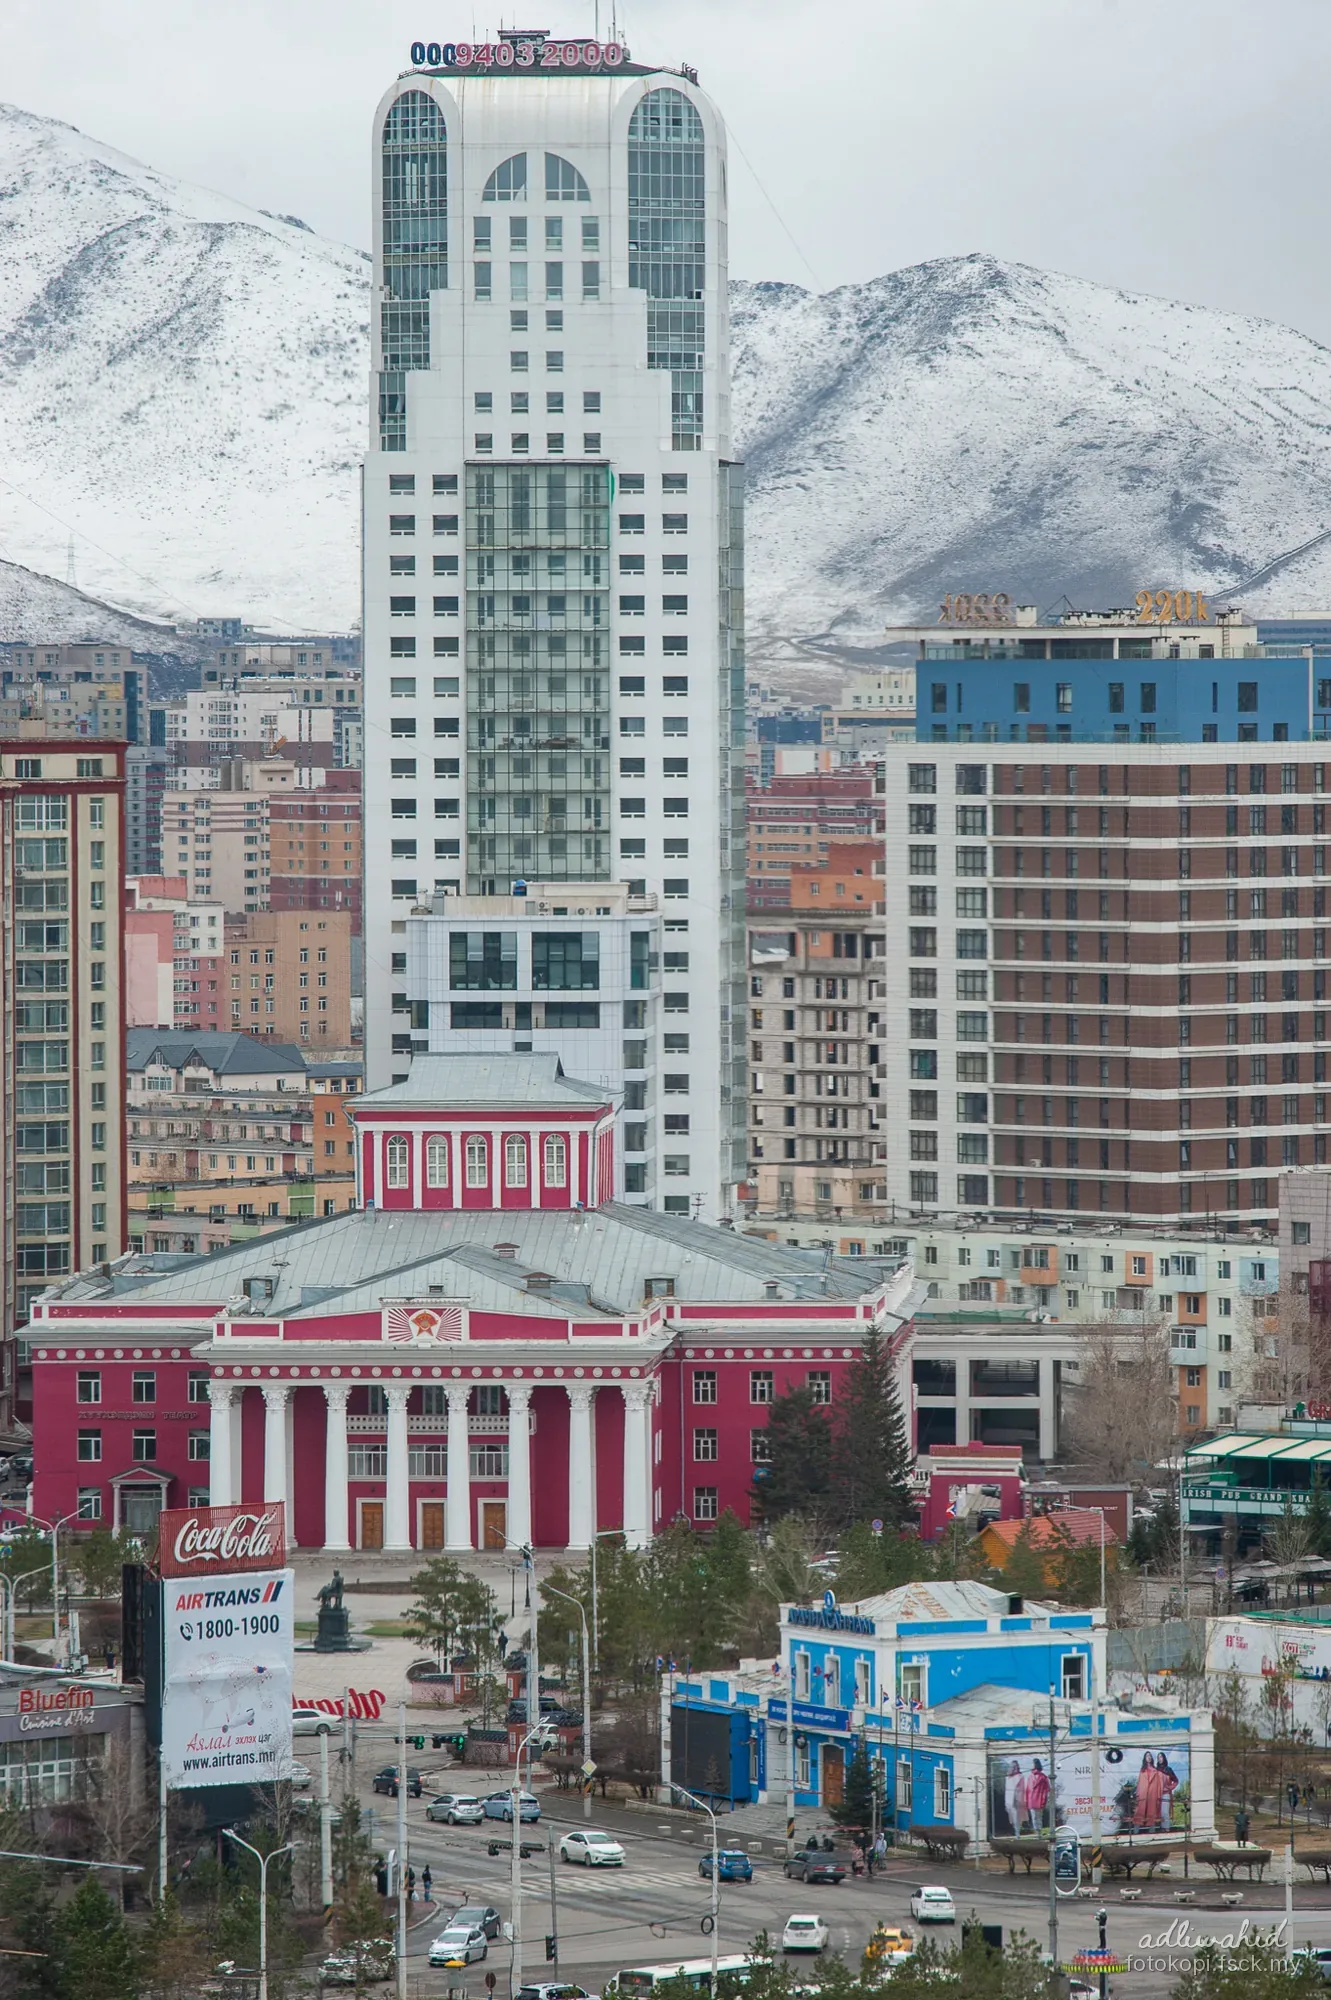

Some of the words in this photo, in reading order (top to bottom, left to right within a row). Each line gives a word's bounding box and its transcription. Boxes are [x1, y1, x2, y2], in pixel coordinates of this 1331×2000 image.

[1182, 1488, 1213, 1499] IRISH
[1221, 1490, 1241, 1500] PUB
[1249, 1492, 1283, 1503] GRAND
[175, 1587, 262, 1612] AIRTRANS
[196, 1614, 280, 1640] 1800-1900
[18, 1684, 95, 1713] Bluefin
[19, 1714, 63, 1732] Cuisine
[183, 1750, 277, 1772] www.airtrans.mn
[1074, 1764, 1106, 1775] NIRN
